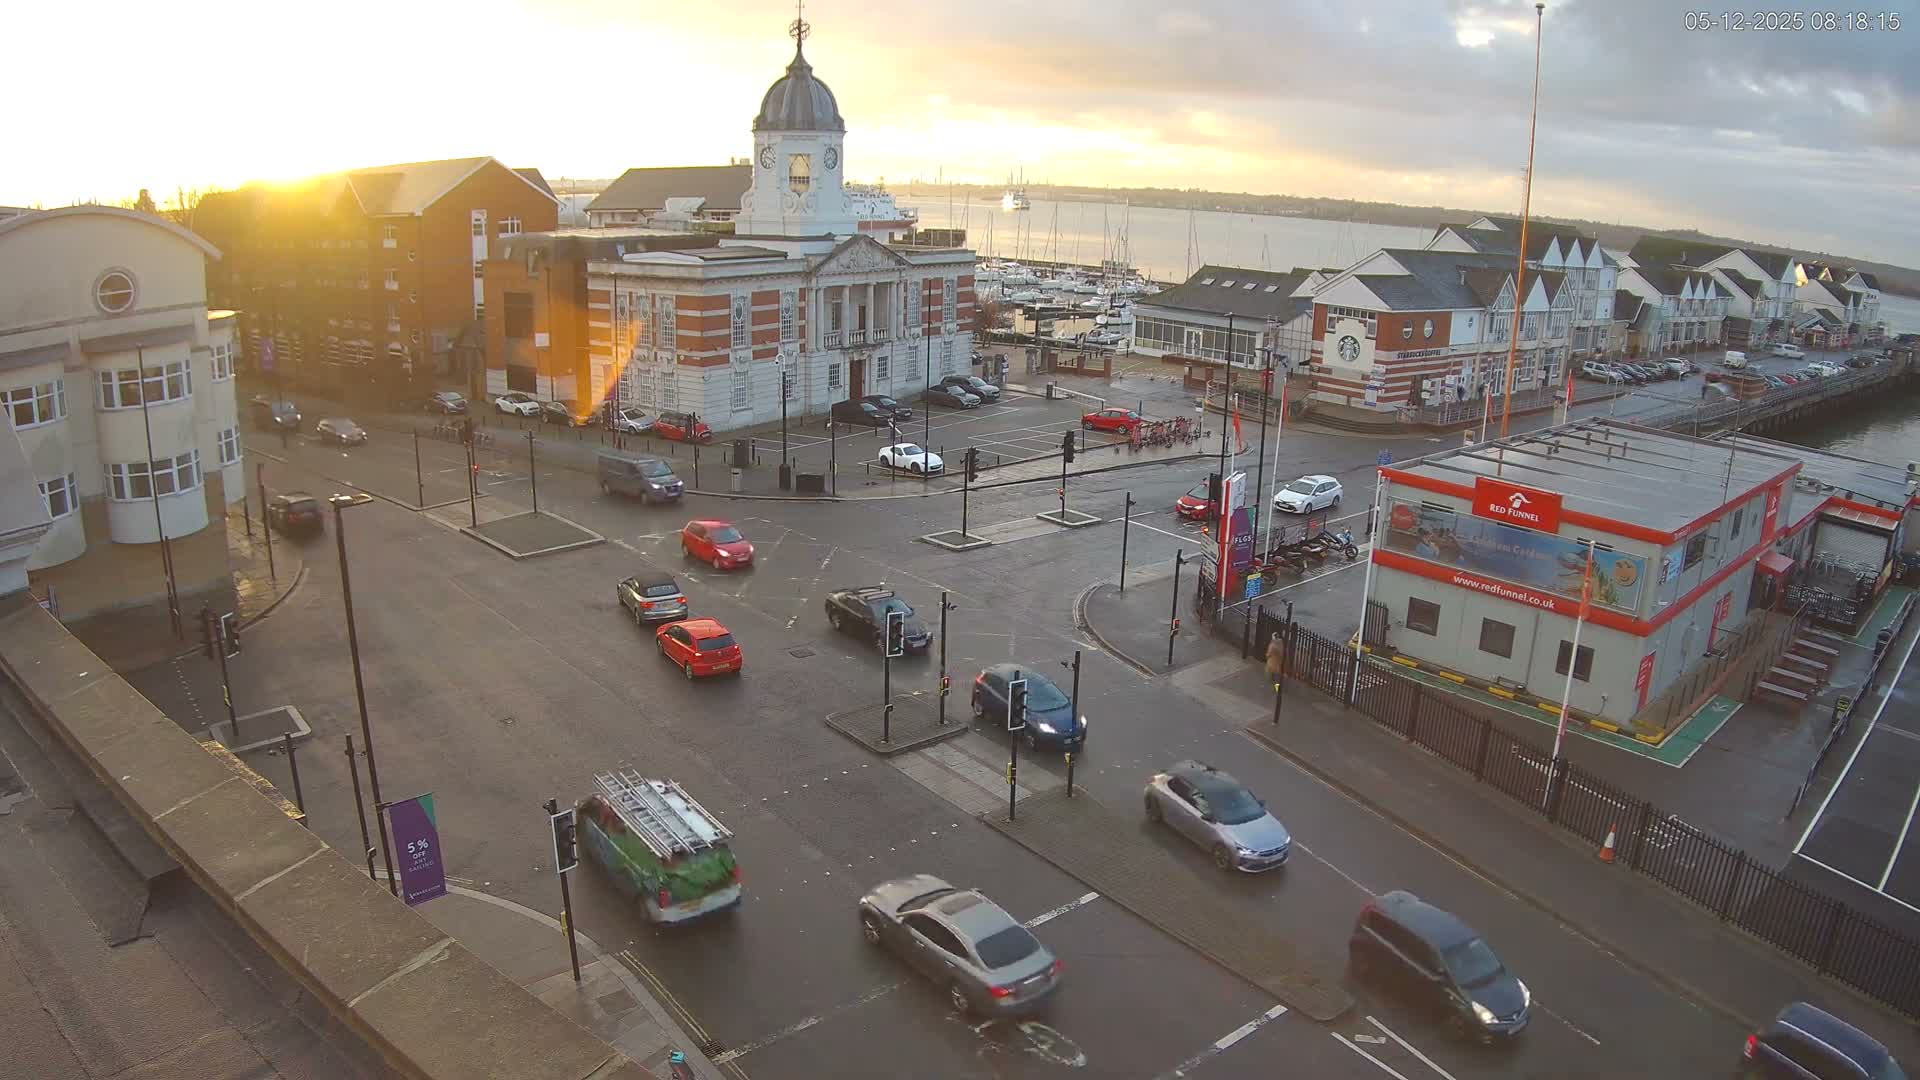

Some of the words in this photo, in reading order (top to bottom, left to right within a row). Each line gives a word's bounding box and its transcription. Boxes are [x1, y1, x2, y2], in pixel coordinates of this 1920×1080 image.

[1489, 503, 1506, 514] RED
[1508, 507, 1539, 522] FUNNEL
[1453, 576, 1556, 609] www.redfunnel.co.uk
[412, 850, 426, 860] OFF
